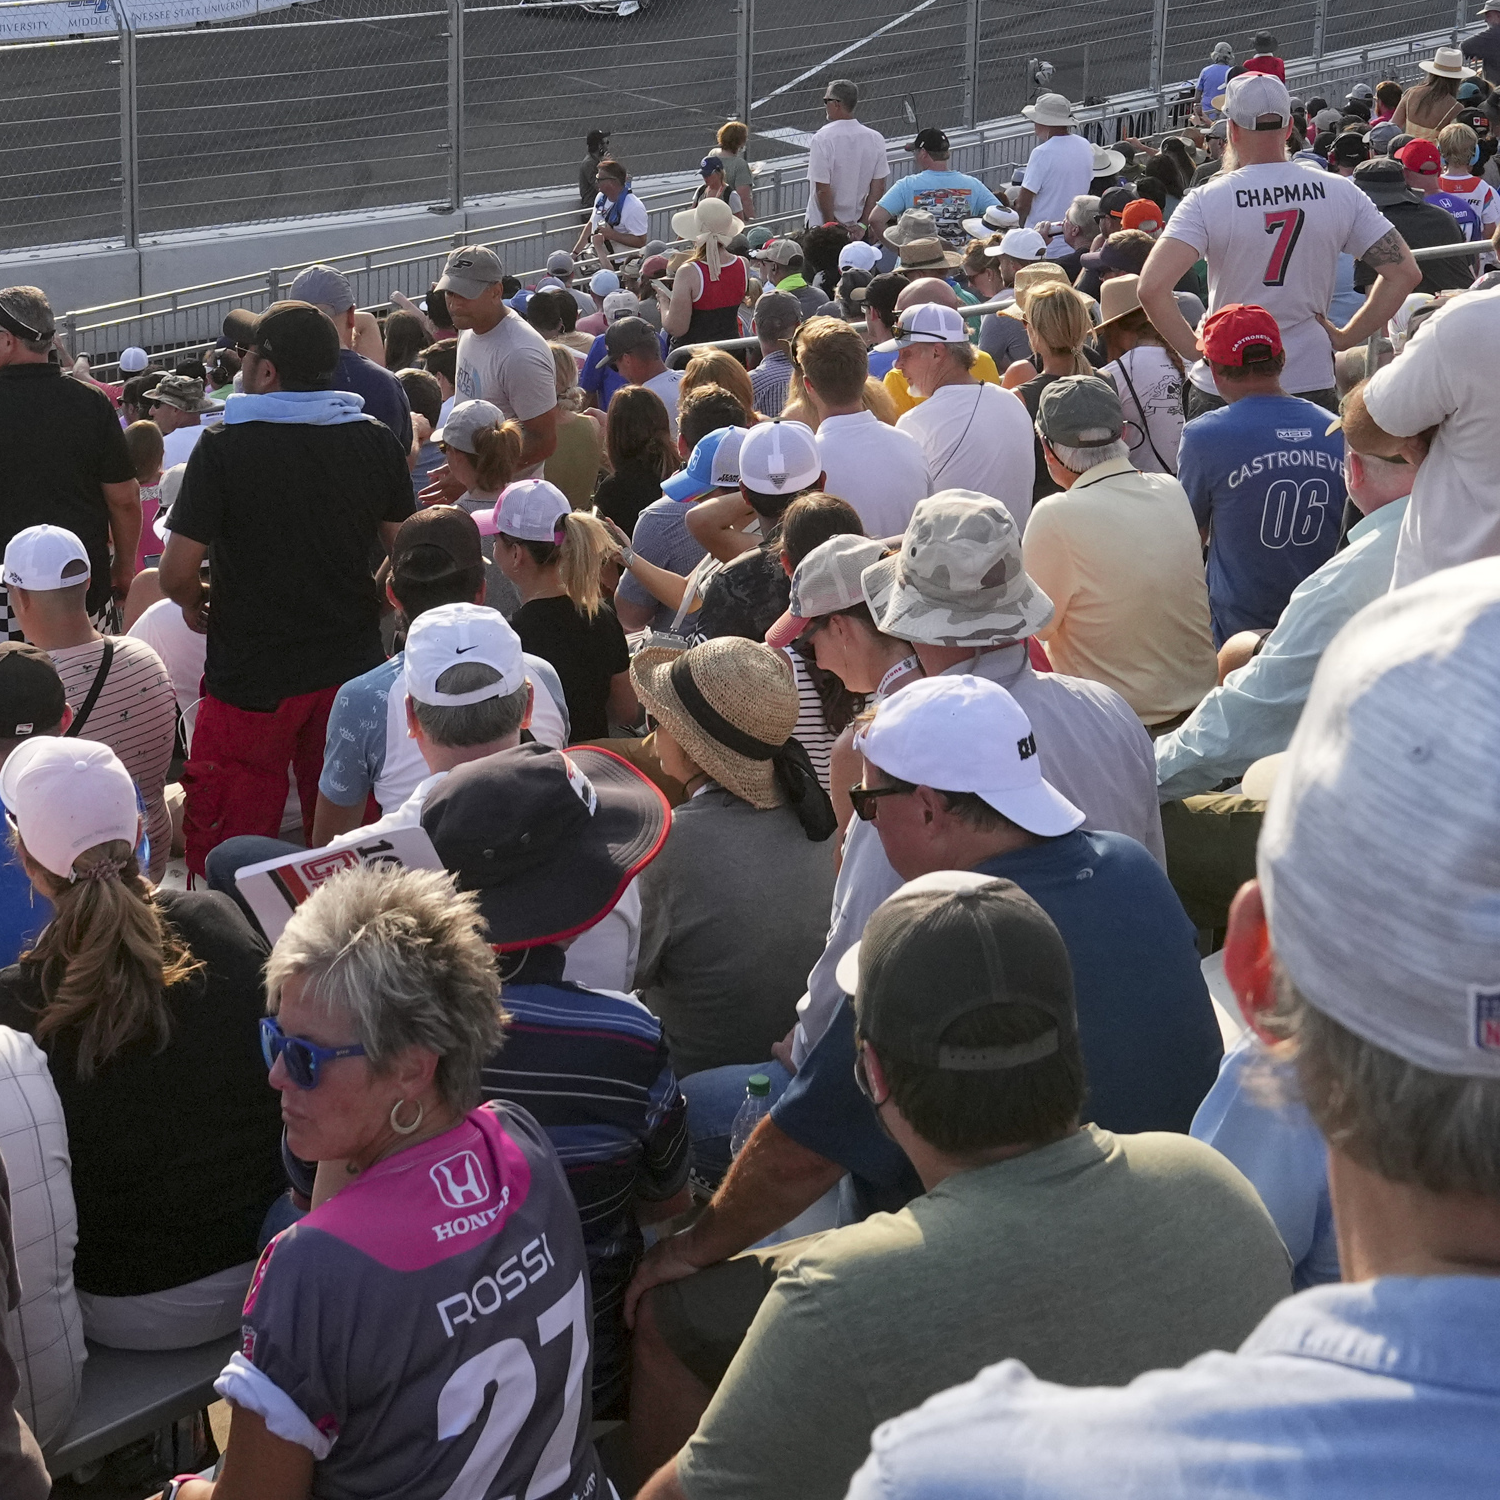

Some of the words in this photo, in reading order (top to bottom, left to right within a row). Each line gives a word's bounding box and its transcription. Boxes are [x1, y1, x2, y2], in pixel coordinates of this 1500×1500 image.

[68, 14, 110, 28] MIDDLE
[173, 5, 202, 20] STATE
[1235, 181, 1326, 209] CHAPMAN
[1262, 207, 1306, 287] 7
[1275, 428, 1313, 440] MSR
[1227, 449, 1347, 489] CASTRONEVE
[1260, 478, 1329, 550] 06
[435, 1232, 556, 1339] ROSSI
[437, 1270, 590, 1500] 27
